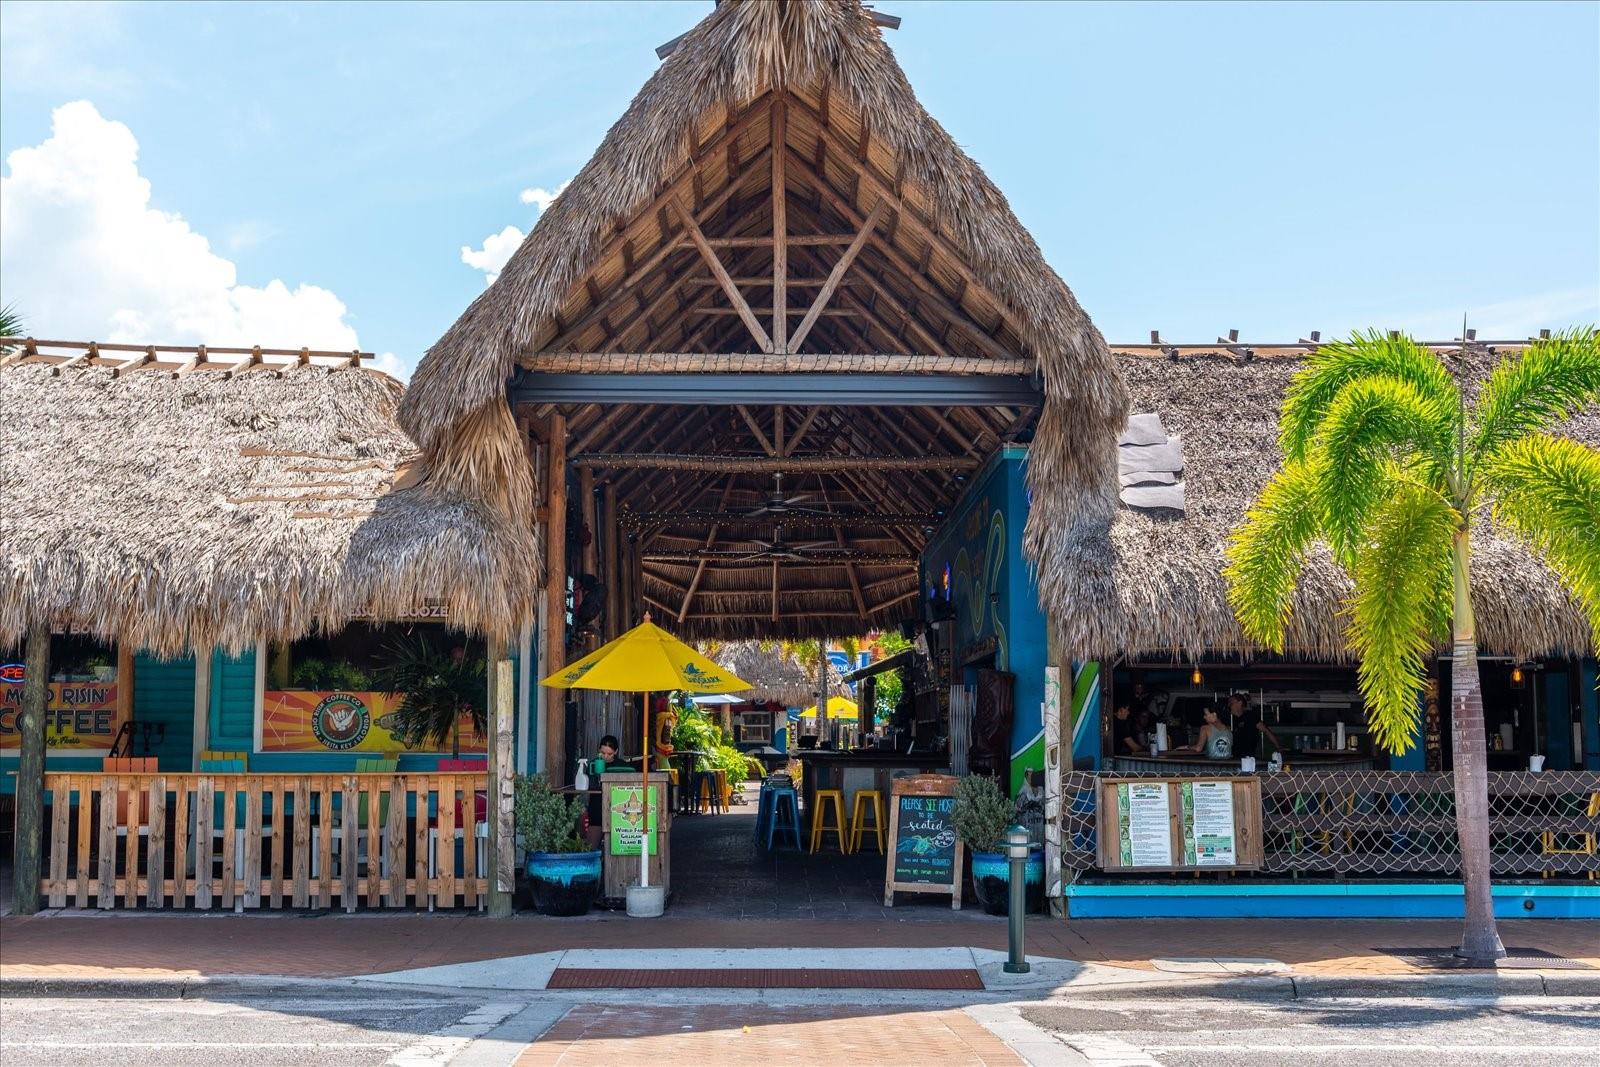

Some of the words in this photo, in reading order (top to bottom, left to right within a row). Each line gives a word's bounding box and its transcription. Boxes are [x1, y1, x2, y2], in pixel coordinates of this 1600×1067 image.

[0, 668, 23, 678] OPE
[5, 688, 55, 705] MO
[62, 688, 109, 705] RISIN'
[326, 694, 350, 703] COFFEE
[0, 707, 112, 734] CFEE
[901, 797, 923, 811] PLEASE
[925, 798, 938, 812] SEE
[908, 819, 943, 831] seated
